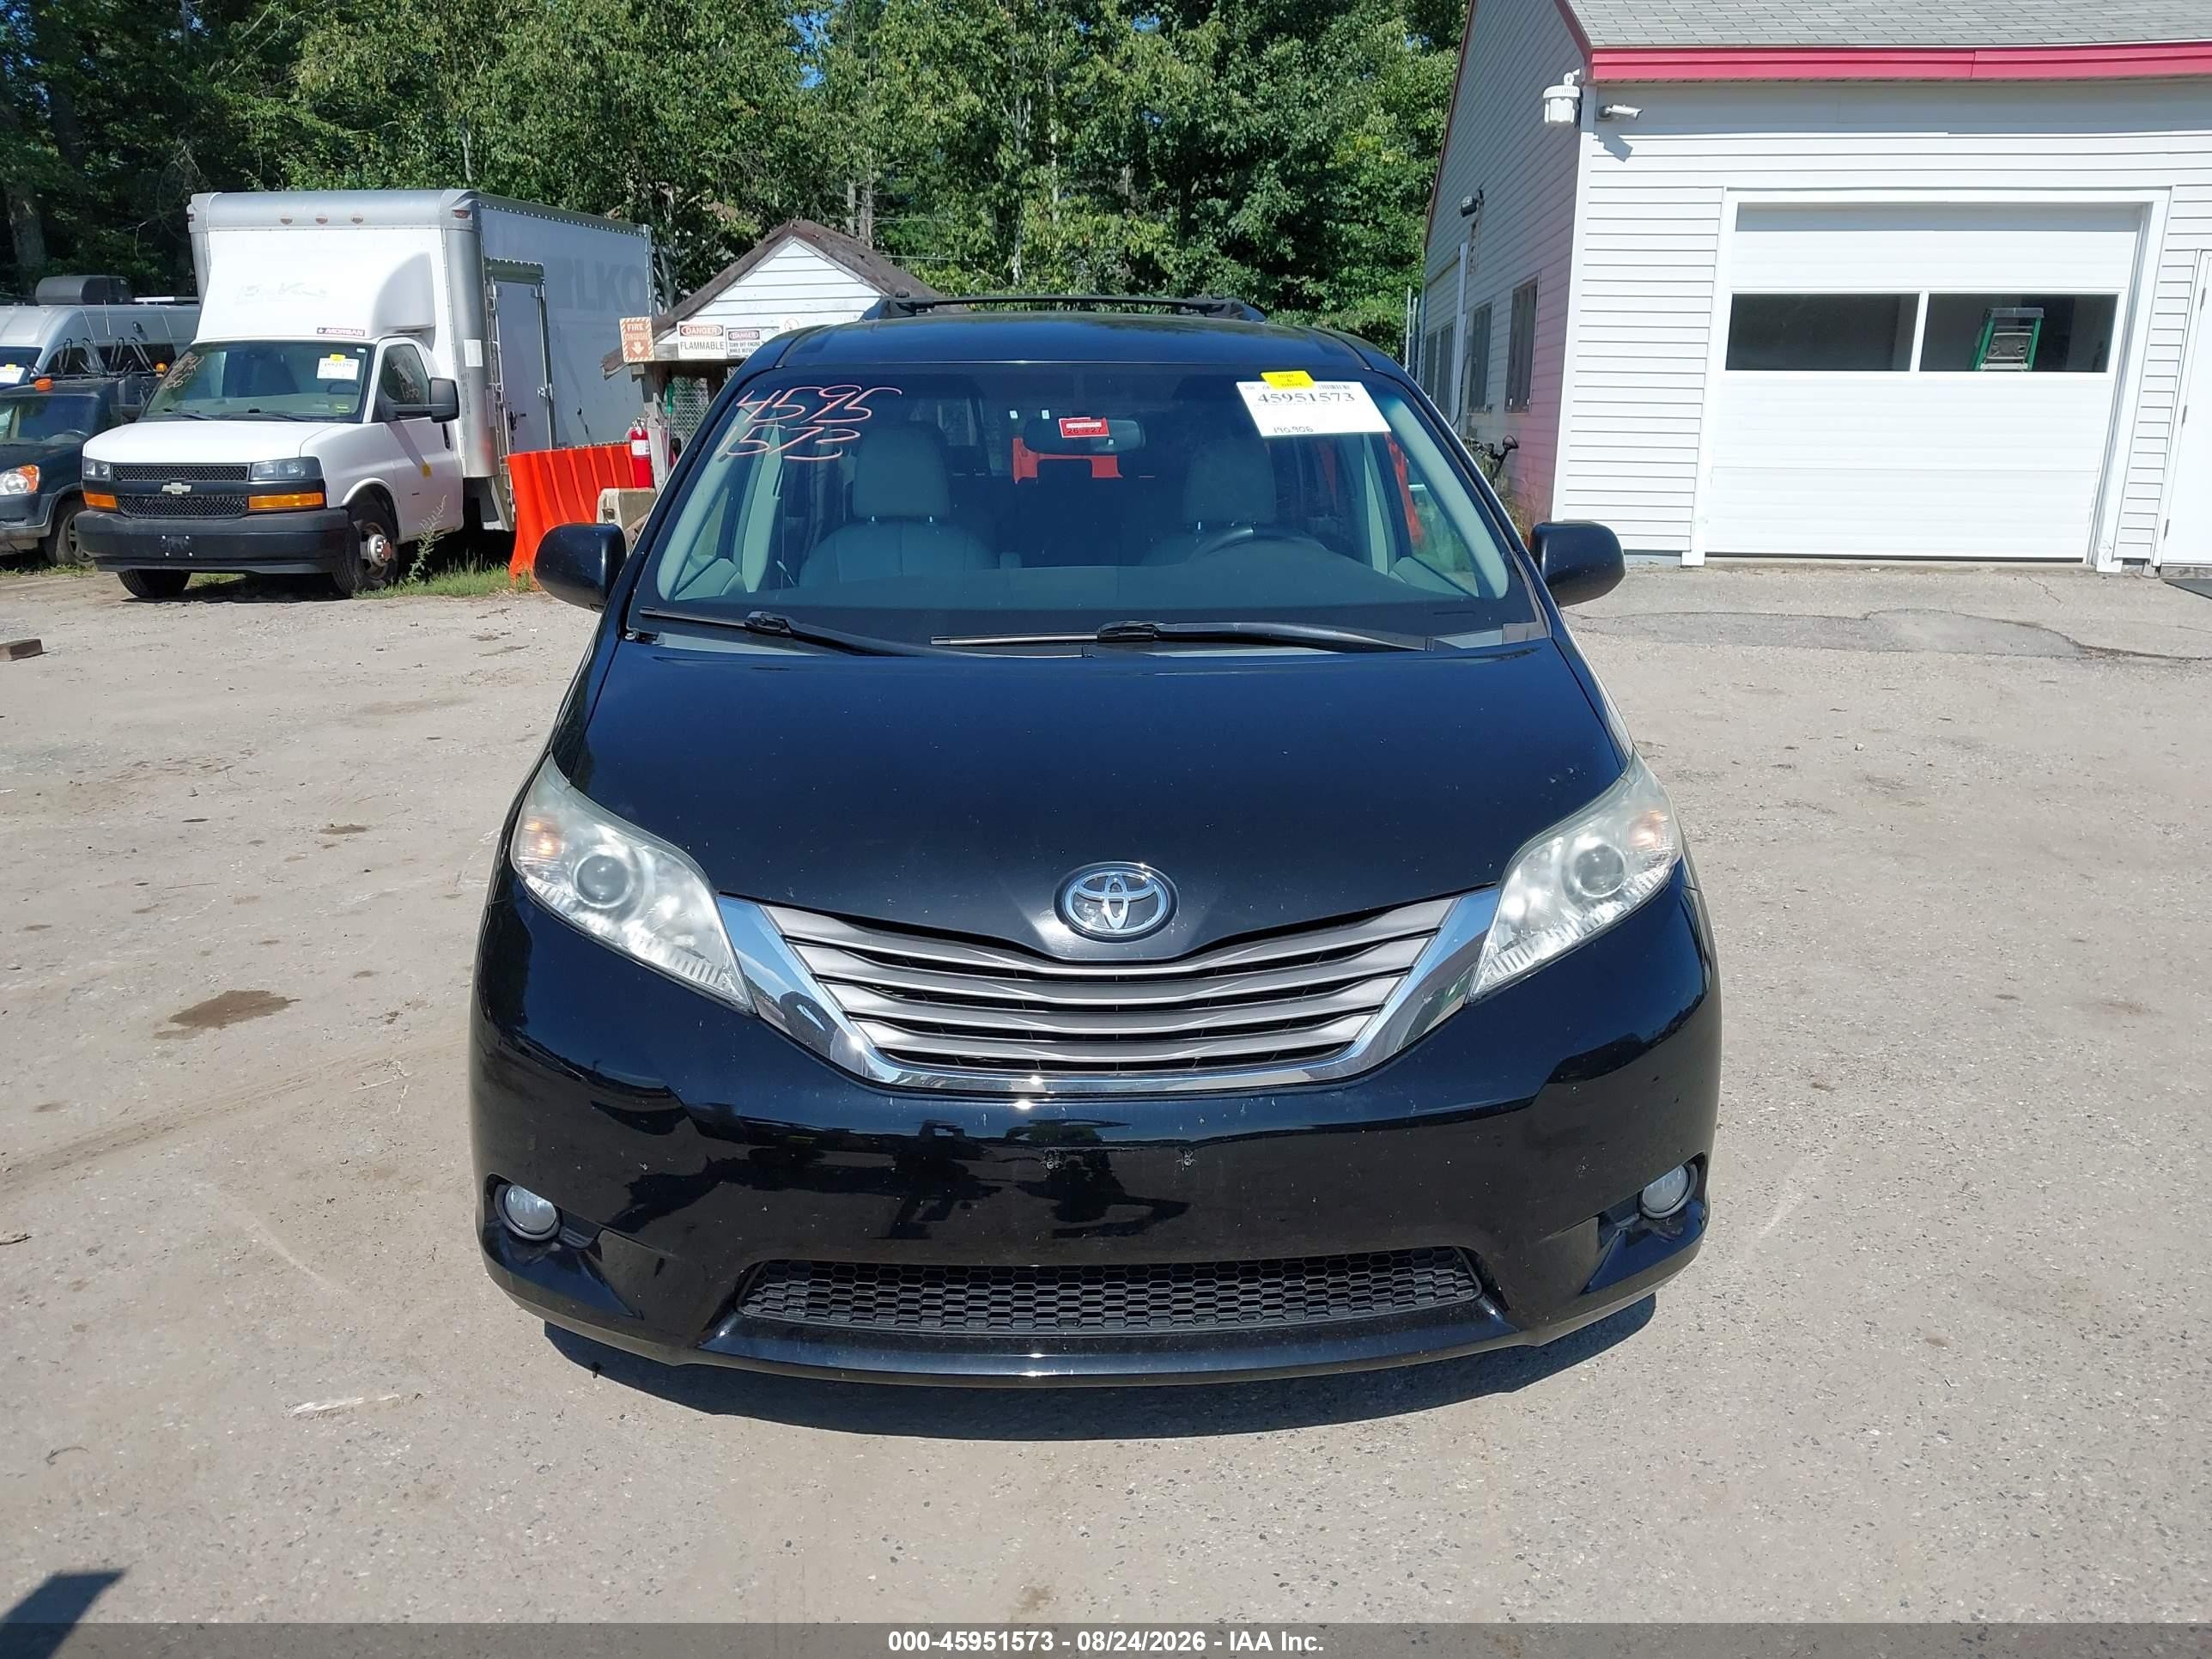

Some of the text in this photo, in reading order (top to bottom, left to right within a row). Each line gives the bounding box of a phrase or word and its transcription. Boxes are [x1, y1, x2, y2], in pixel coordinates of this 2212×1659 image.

[627, 323, 644, 331] FIRE
[680, 341, 725, 350] FLAMMABLE
[1258, 392, 1355, 403] 45951573
[736, 385, 903, 423] 4595
